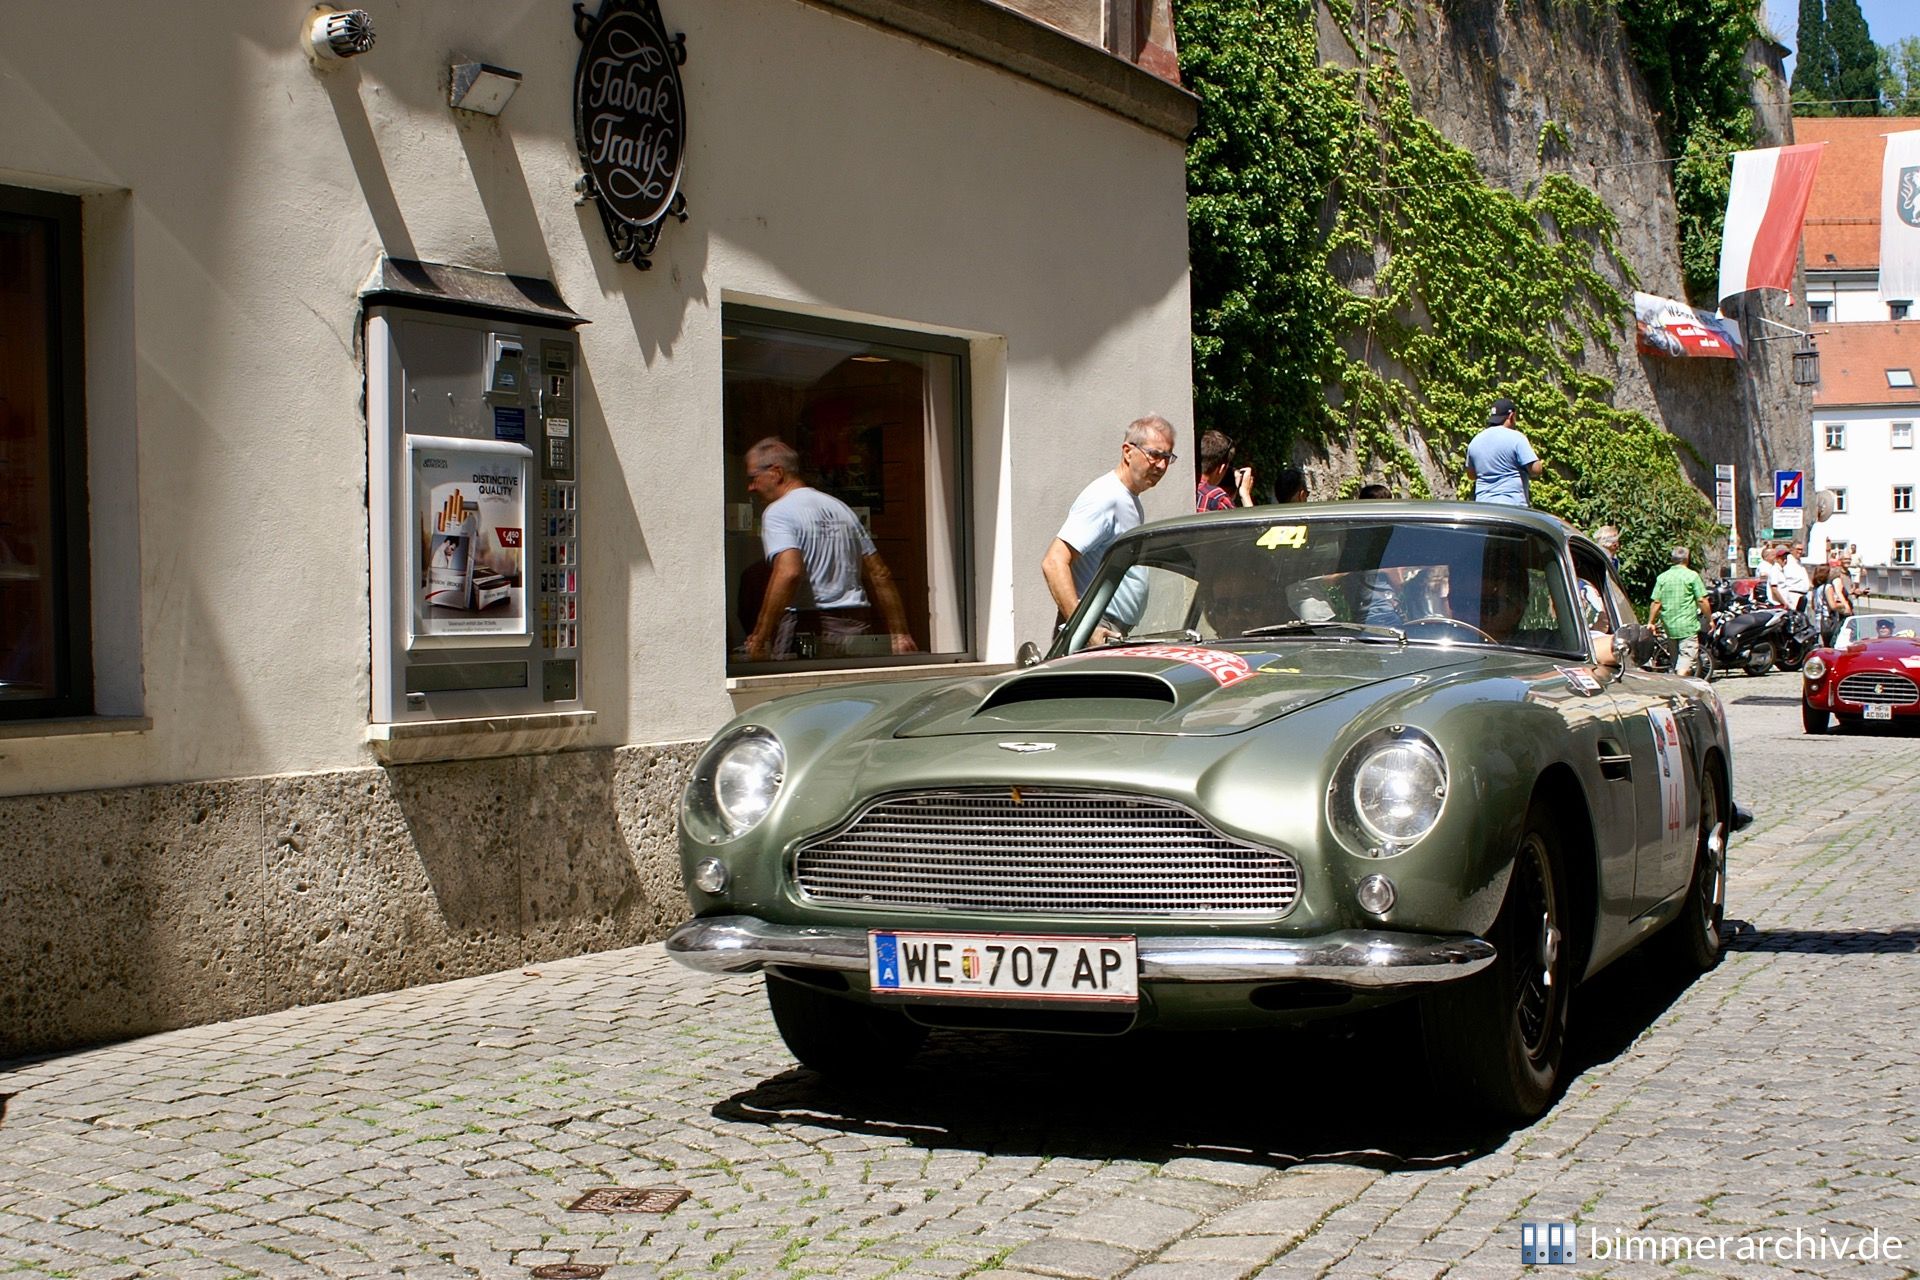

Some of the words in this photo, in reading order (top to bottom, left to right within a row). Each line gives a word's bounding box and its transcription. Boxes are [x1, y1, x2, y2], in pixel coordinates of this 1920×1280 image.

[589, 57, 674, 124] Tabak
[590, 113, 674, 177] Trafik
[472, 474, 518, 486] DISTINCTIVE
[478, 485, 513, 496] QUALITY
[1256, 525, 1307, 549] 44
[882, 967, 895, 980] A
[902, 942, 954, 984] WE
[985, 945, 1059, 987] 707
[1071, 948, 1122, 989] AP
